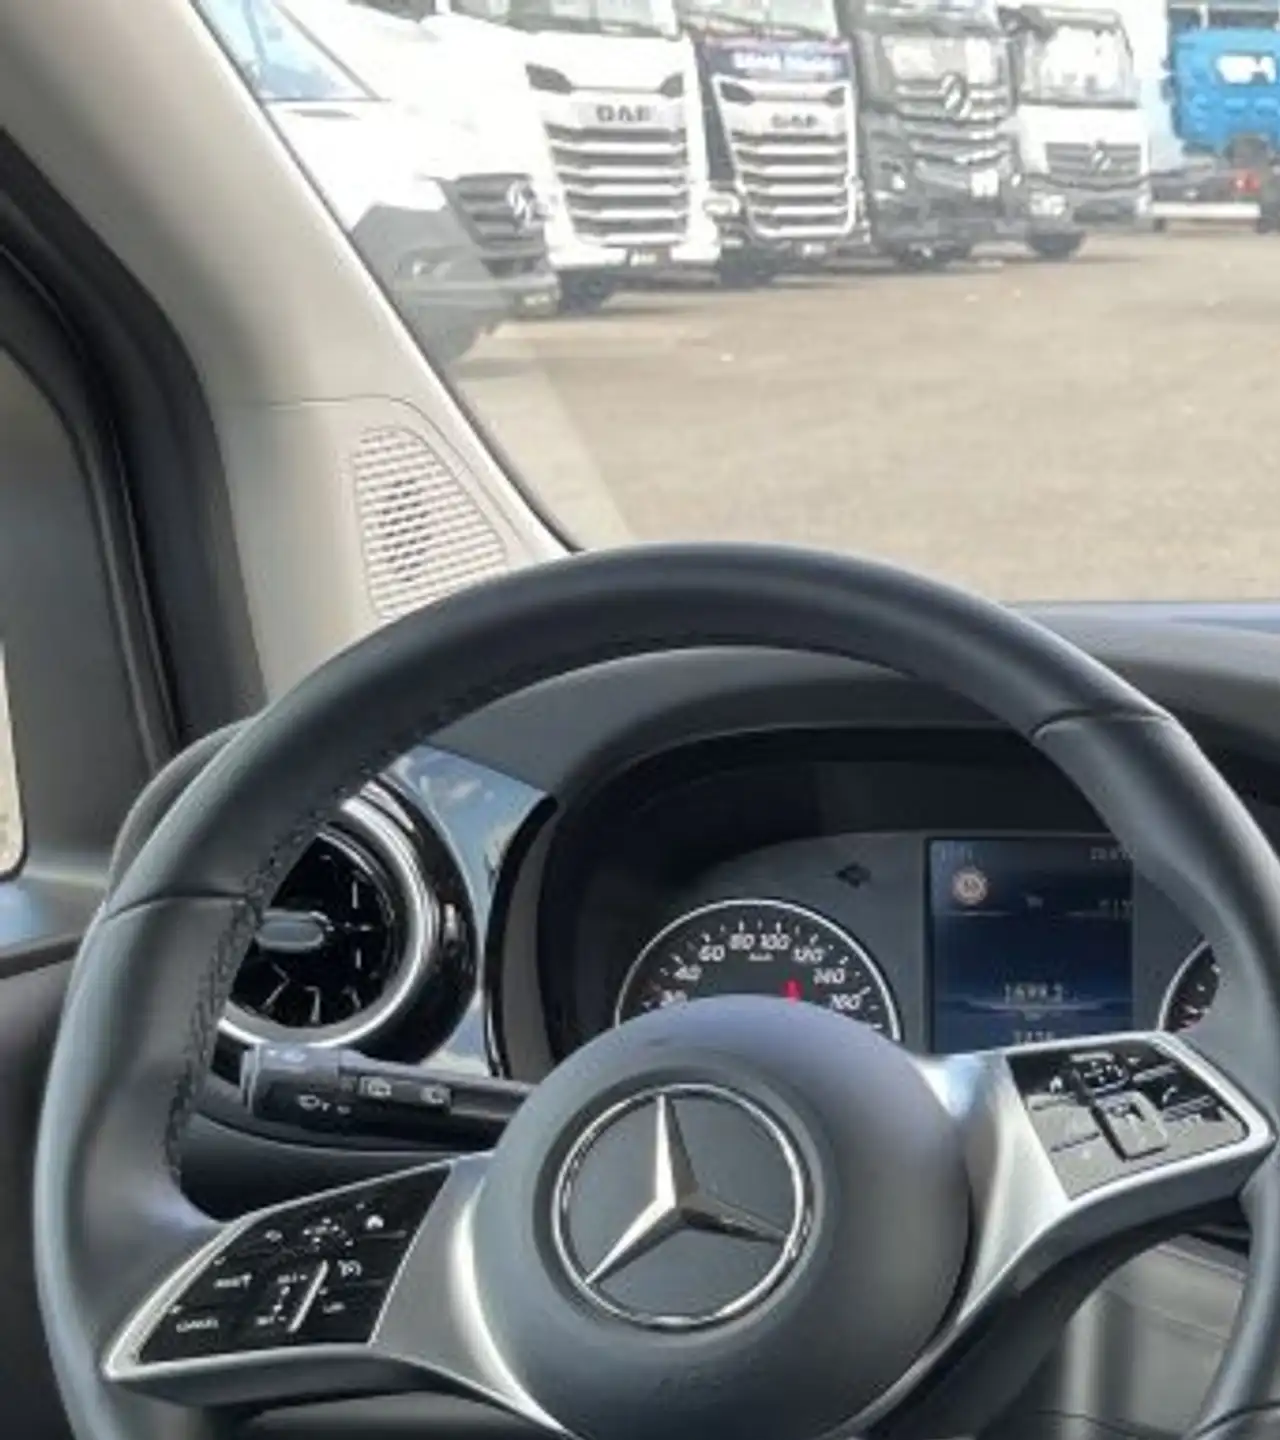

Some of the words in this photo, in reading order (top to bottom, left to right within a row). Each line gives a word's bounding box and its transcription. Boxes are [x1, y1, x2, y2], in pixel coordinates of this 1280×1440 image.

[730, 934, 754, 949] 80
[760, 934, 791, 950] 100
[700, 945, 725, 961] 60
[674, 966, 700, 980] 40
